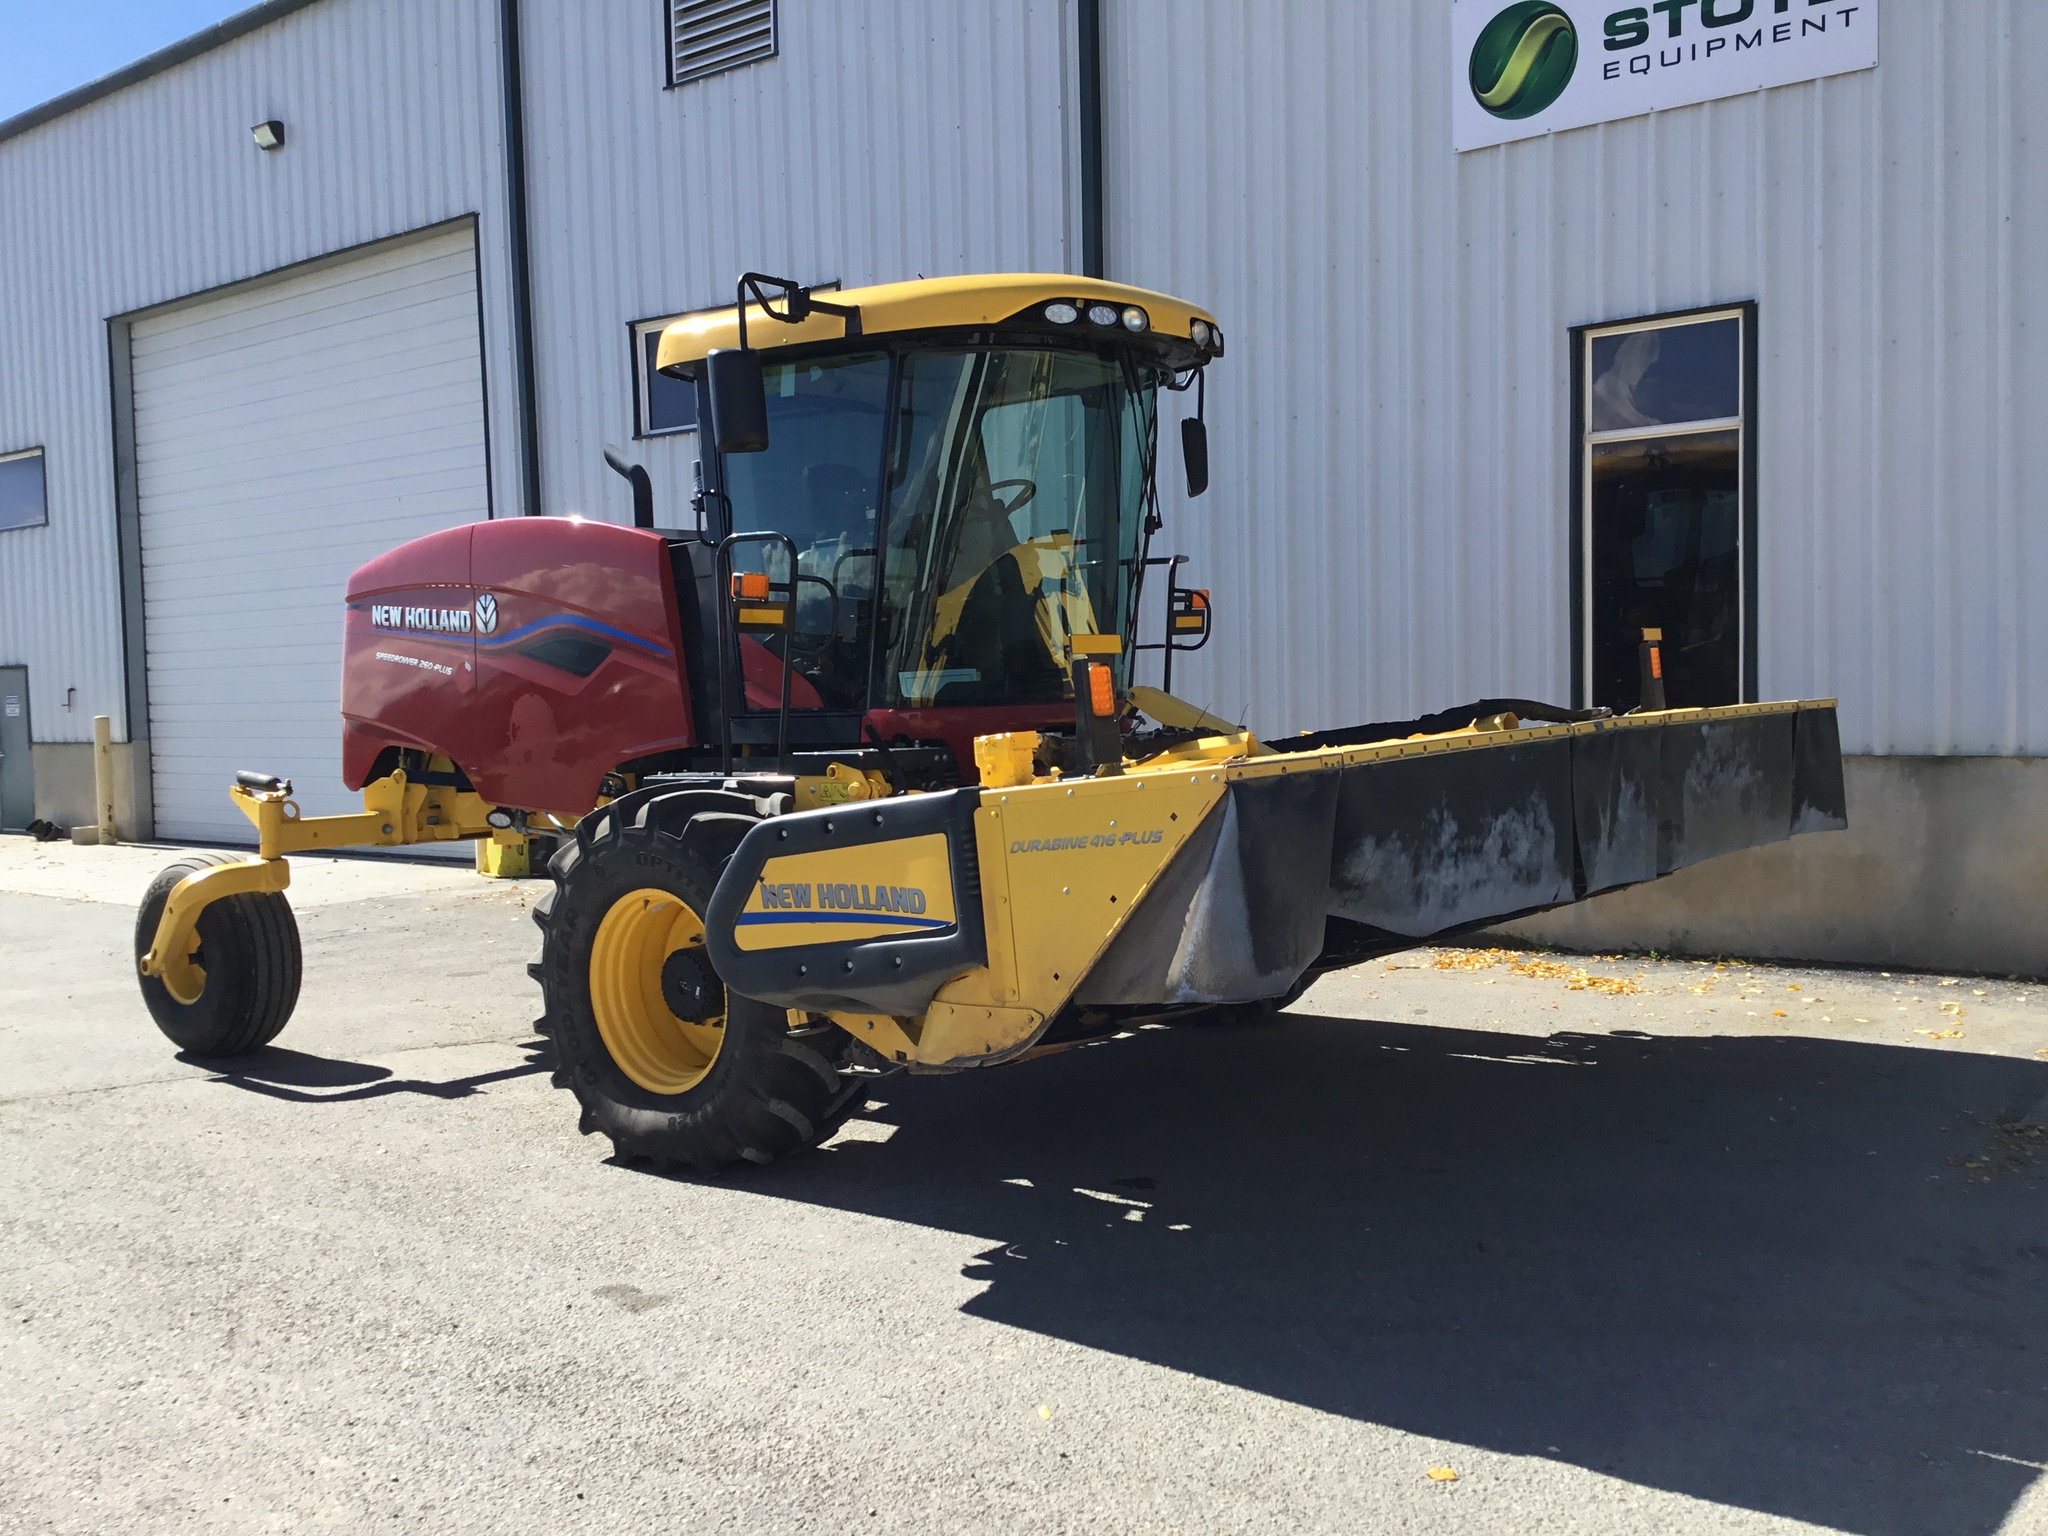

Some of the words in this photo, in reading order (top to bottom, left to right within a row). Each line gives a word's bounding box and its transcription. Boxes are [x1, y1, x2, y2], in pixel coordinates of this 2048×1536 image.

[1603, 0, 1836, 51] STO
[1603, 7, 1859, 81] EQUIPMENT
[371, 604, 402, 628] NEW
[404, 607, 472, 633] HOLLAND
[375, 651, 419, 666] SPEEDROWER
[418, 659, 433, 670] 260
[1010, 835, 1089, 854] DURABINE
[1090, 833, 1117, 848] 416
[759, 883, 811, 909] NEW
[816, 883, 927, 915] HOLLAND
